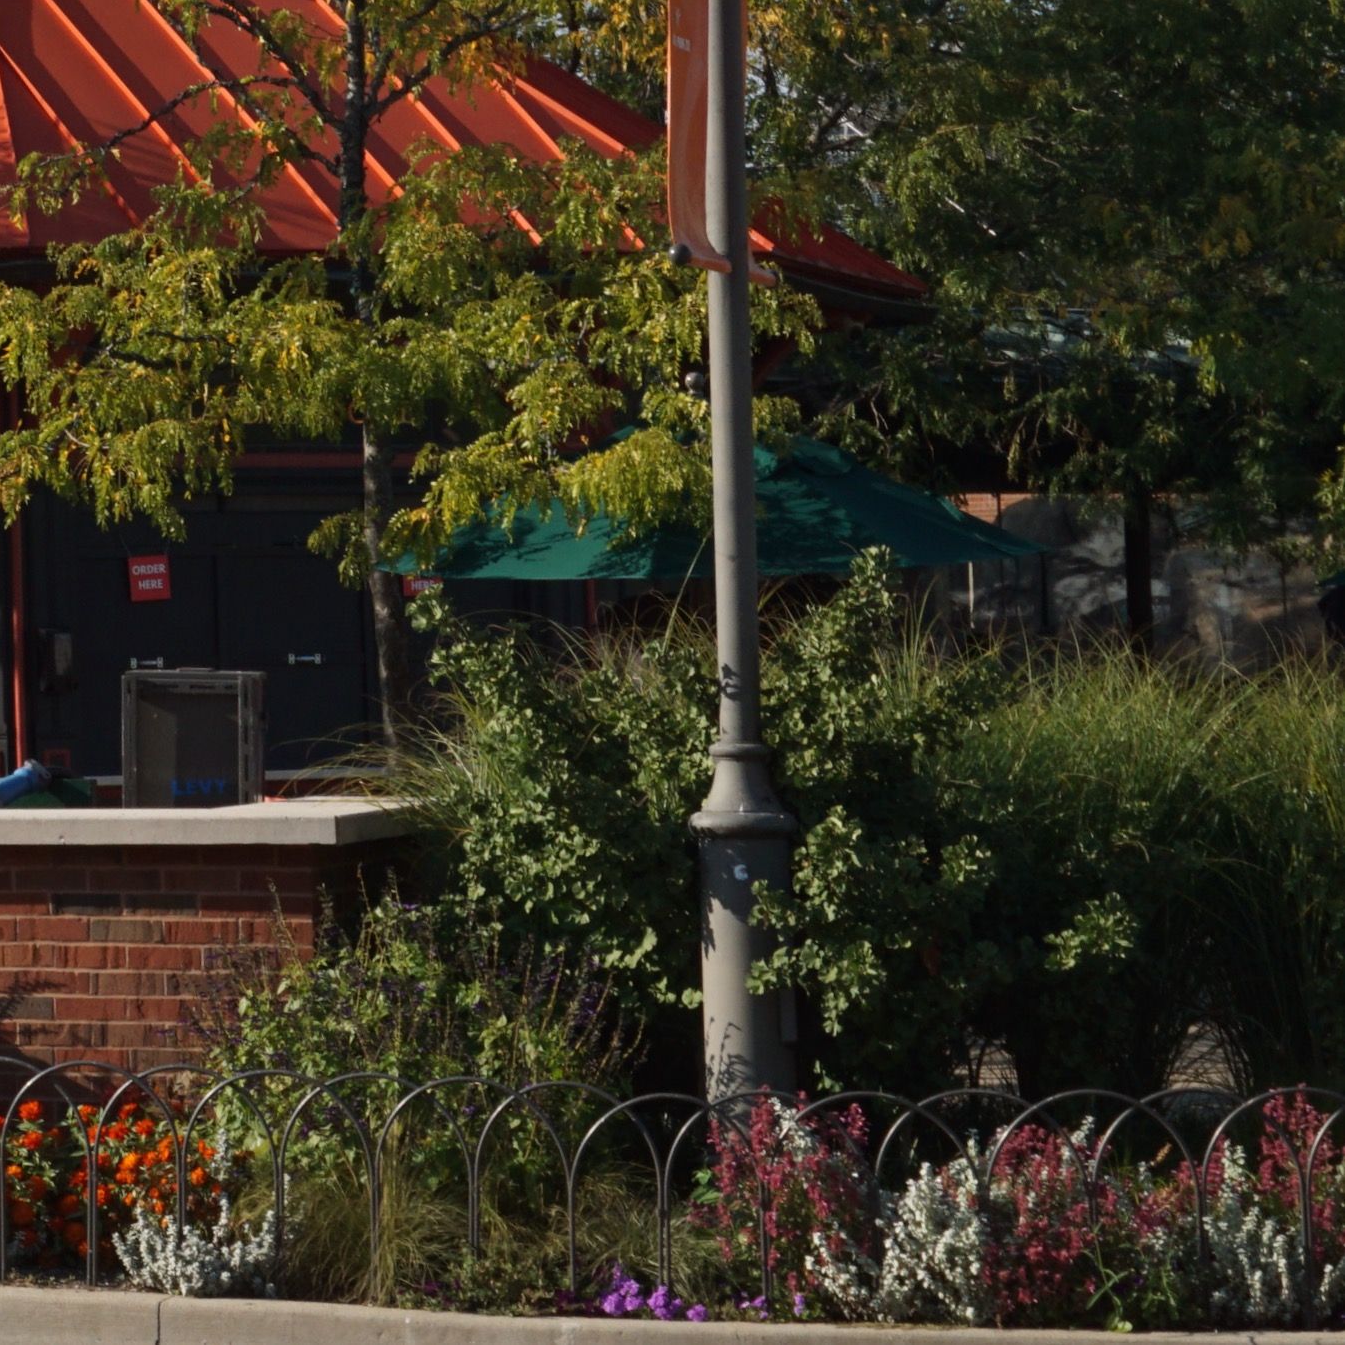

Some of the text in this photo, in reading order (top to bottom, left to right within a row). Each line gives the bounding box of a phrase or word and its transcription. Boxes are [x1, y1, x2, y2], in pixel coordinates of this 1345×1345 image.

[131, 563, 167, 576] ORDER
[138, 578, 164, 590] HERE
[170, 777, 226, 797] LEVY
